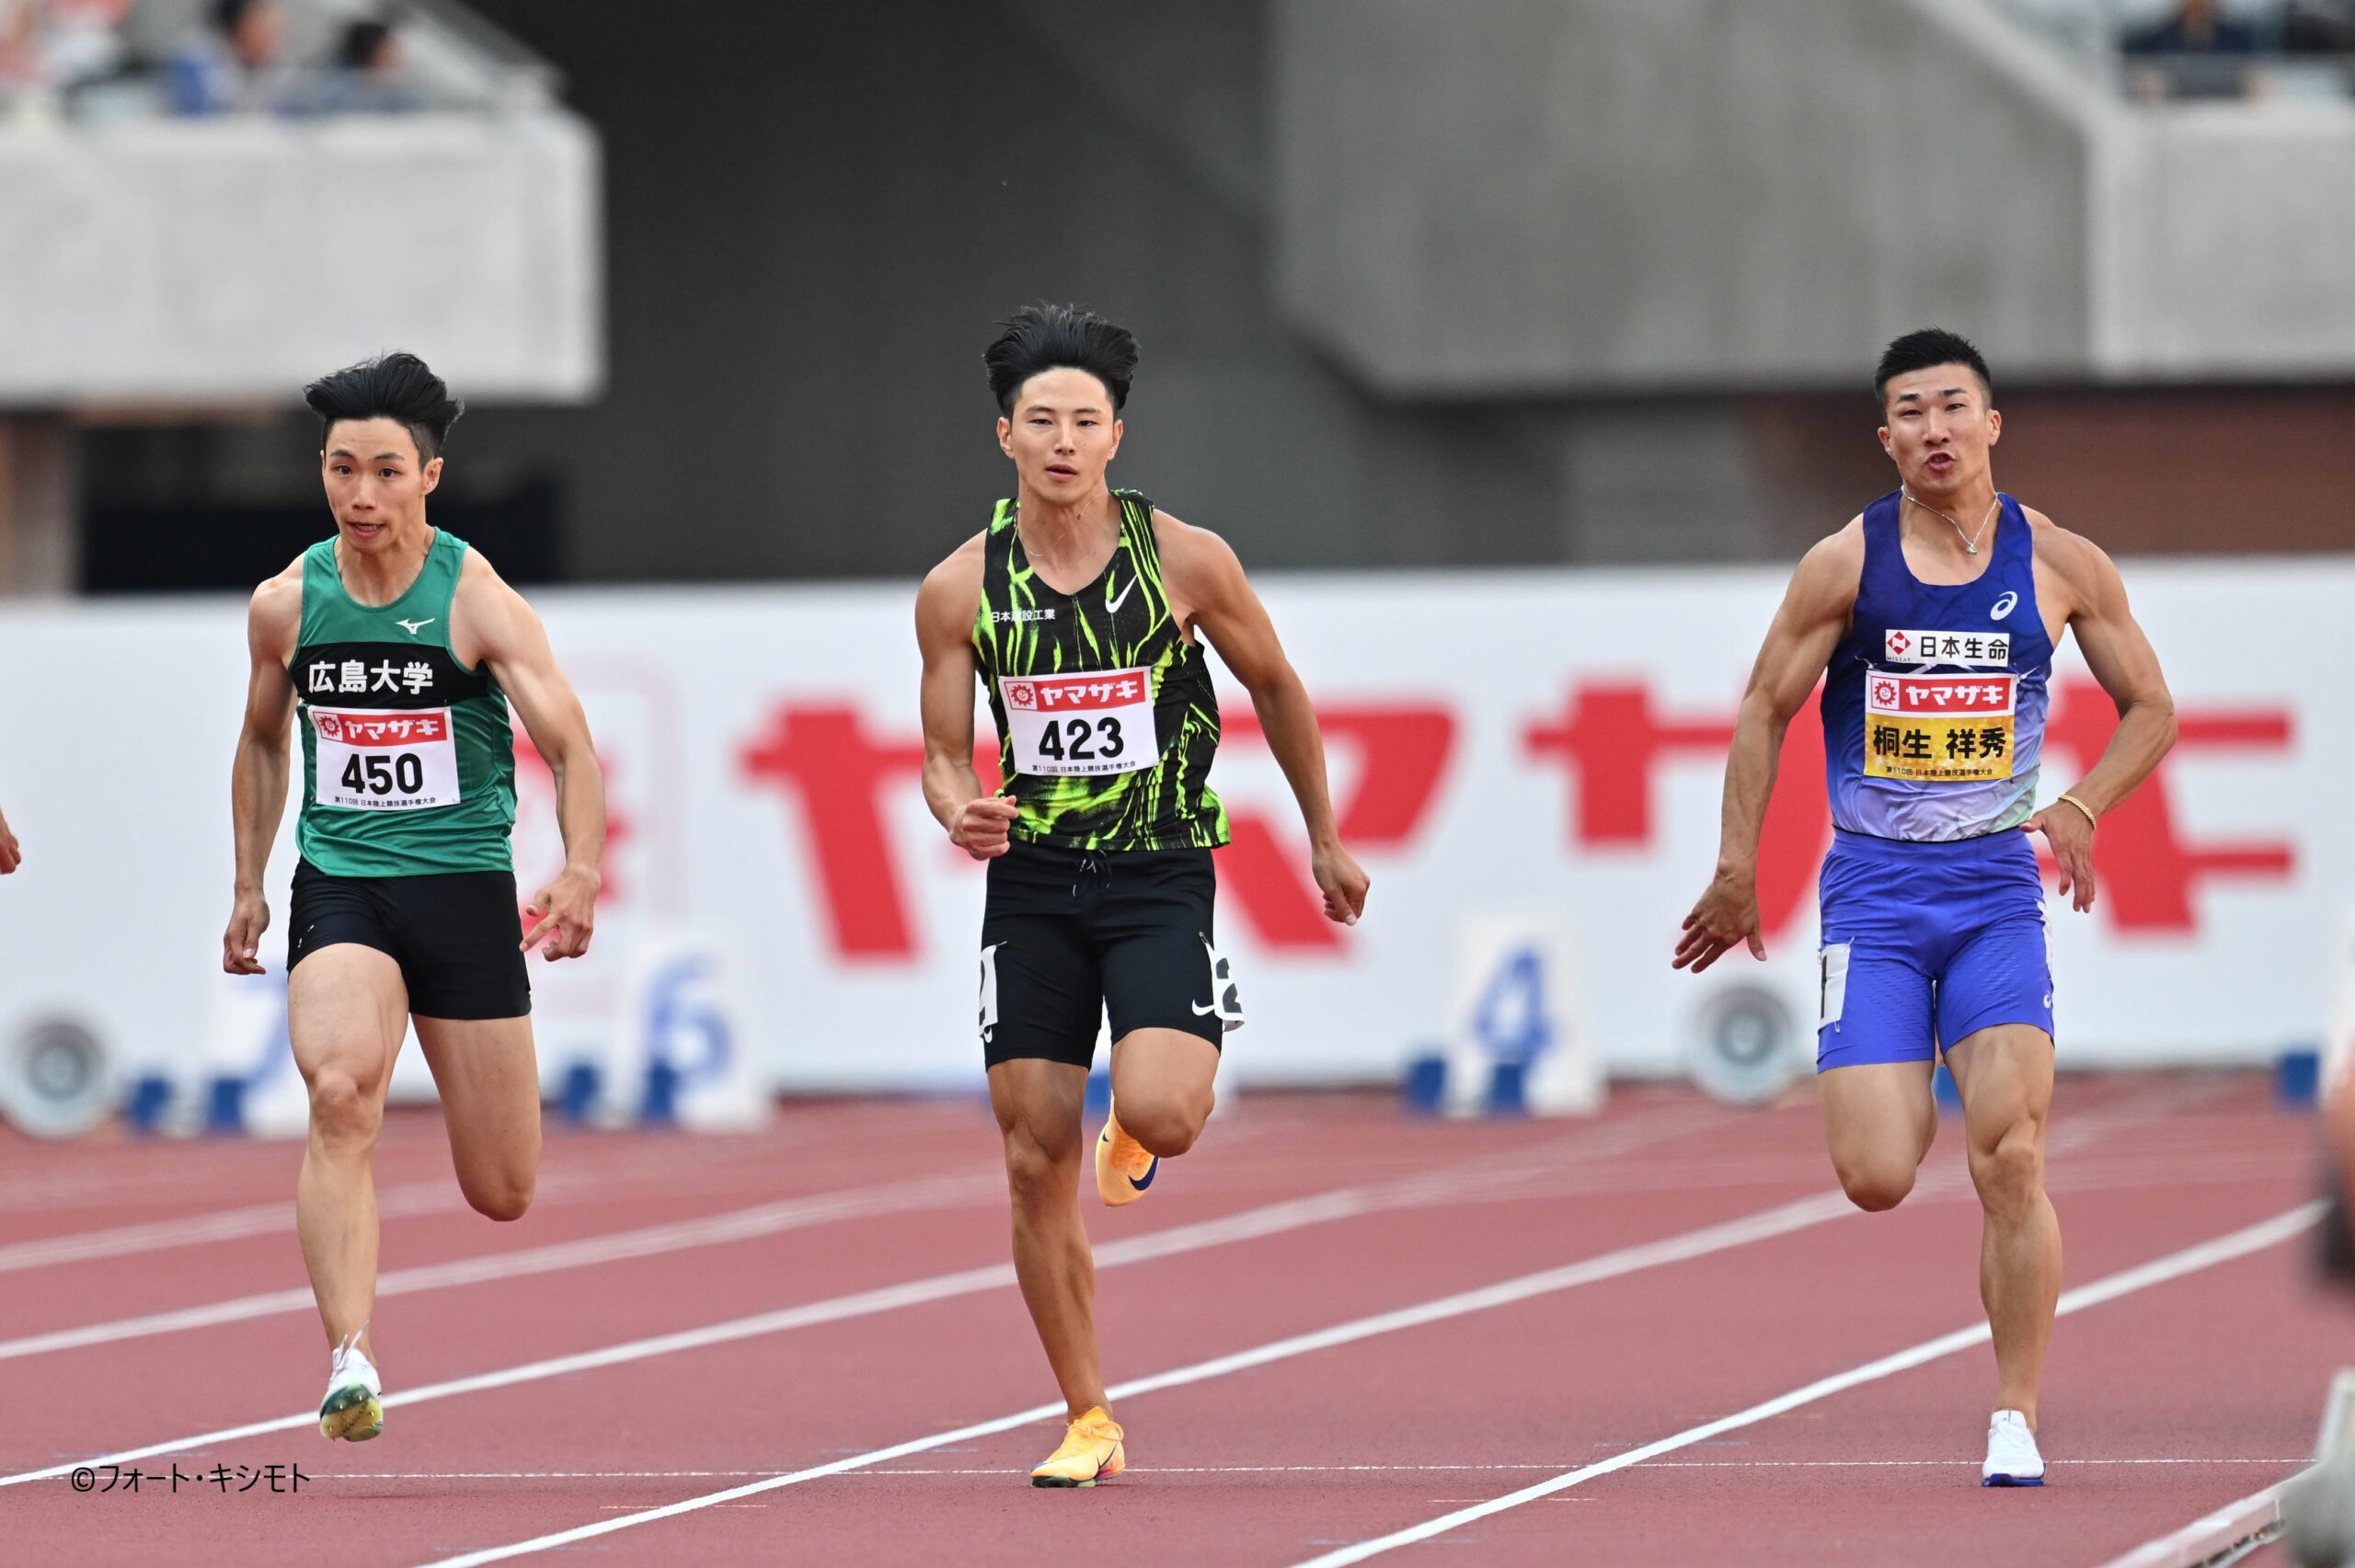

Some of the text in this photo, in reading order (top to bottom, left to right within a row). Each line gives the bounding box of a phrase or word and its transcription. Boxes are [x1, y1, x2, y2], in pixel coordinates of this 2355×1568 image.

[1920, 635, 2009, 661] 日本生命
[307, 658, 434, 695] 広島大学
[1040, 680, 1139, 706] ヤマザキ
[1905, 684, 2004, 706] ヤマザキ
[344, 718, 440, 740] ヤマザキ
[1038, 716, 1124, 761] 423
[1872, 724, 2006, 760] 桐生 祥秀
[340, 752, 424, 795] 450
[1031, 760, 1136, 773] 第110回 日本陸上競技選手権大会
[1886, 765, 1993, 777] 第110回 日本陸上競技選手権大会
[334, 795, 437, 807] 第110回 日本陸上競技選手権大会
[645, 951, 733, 1080] 6
